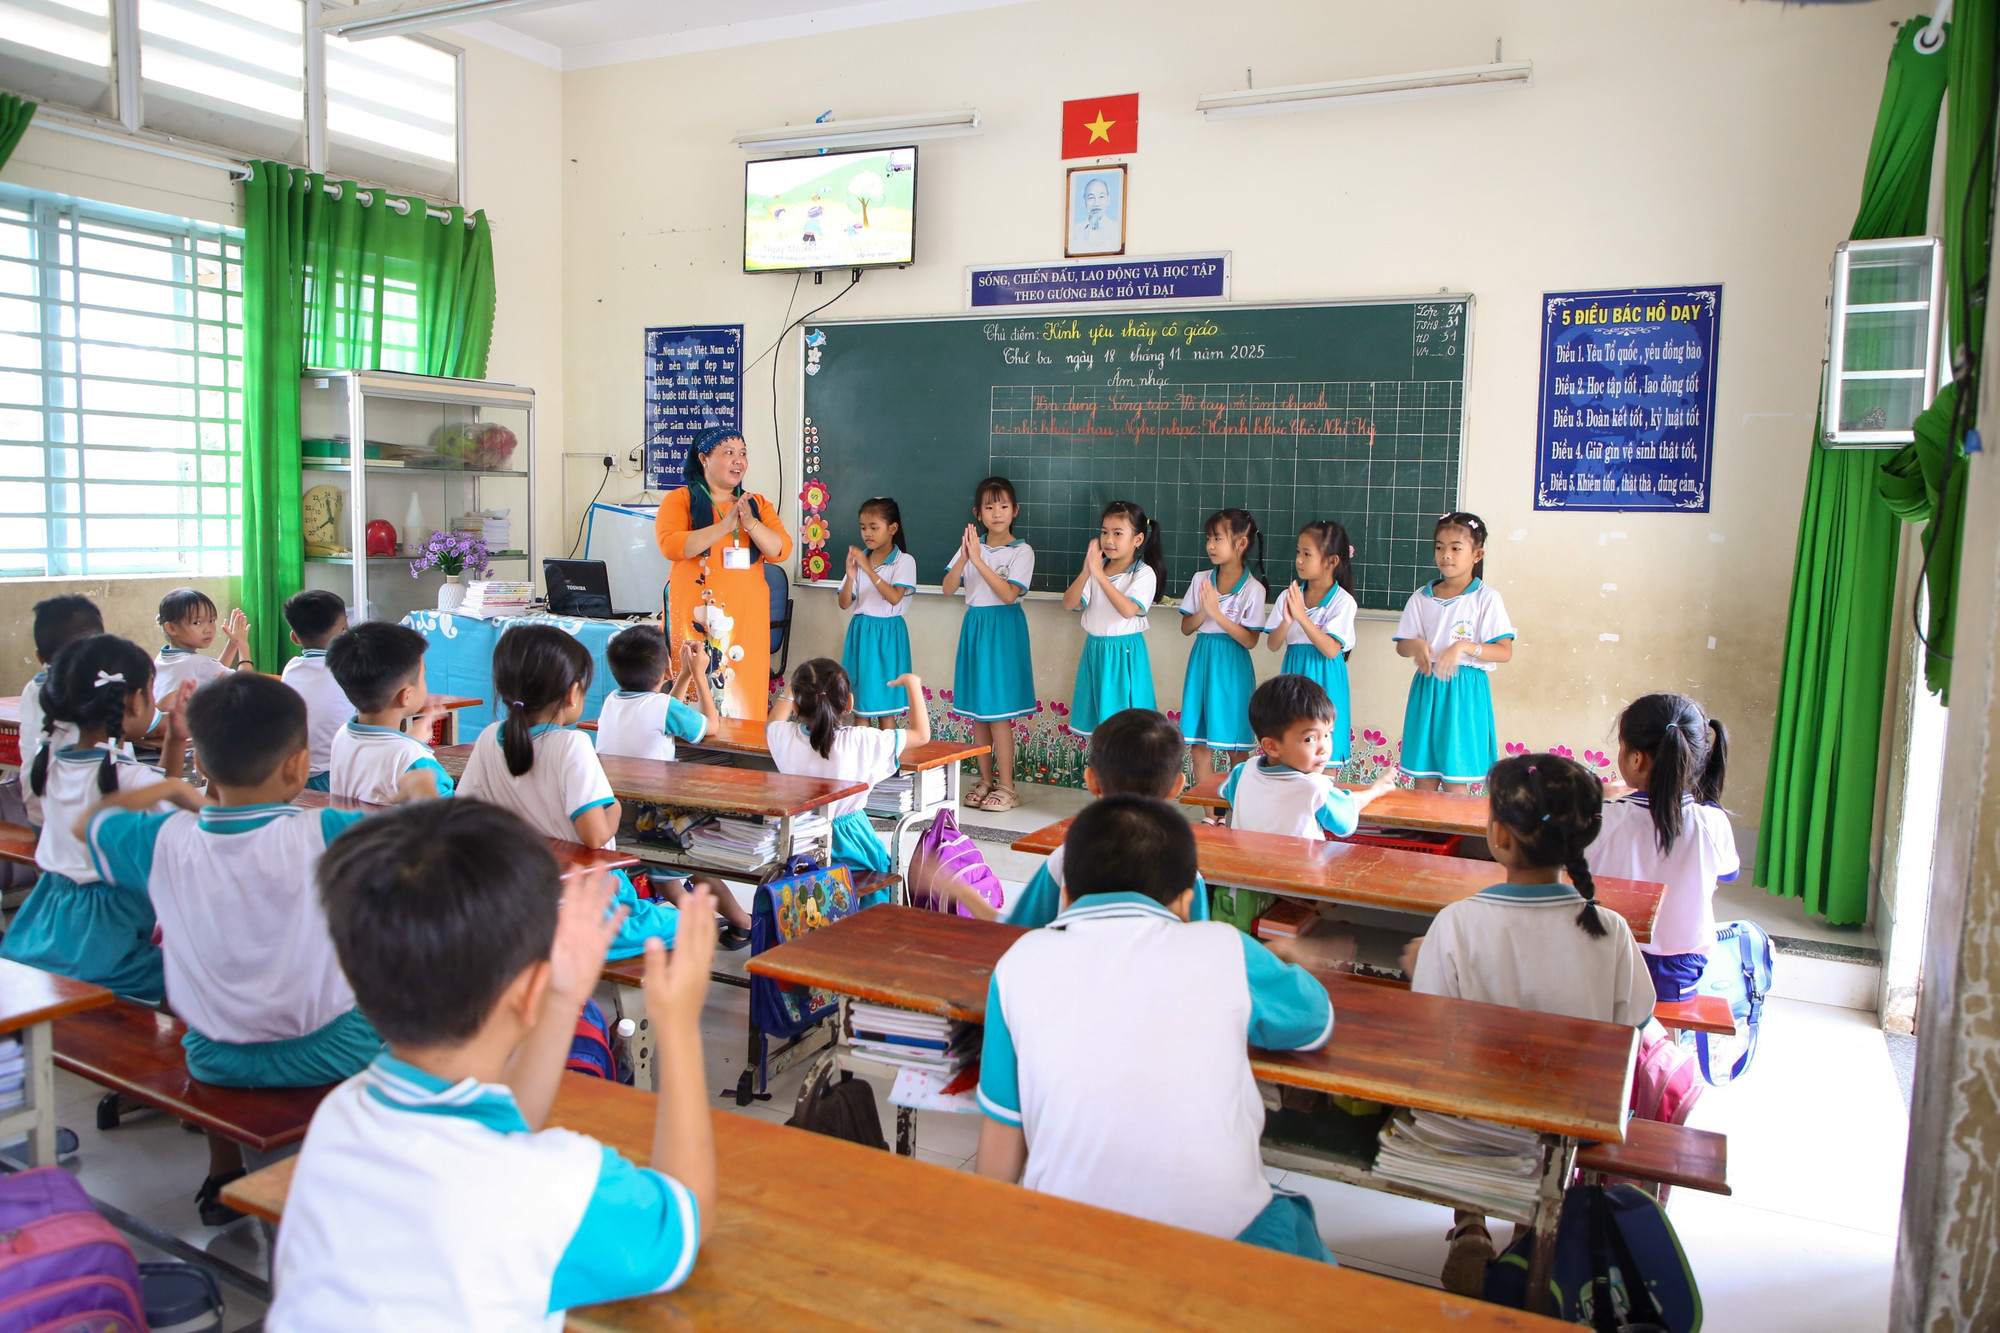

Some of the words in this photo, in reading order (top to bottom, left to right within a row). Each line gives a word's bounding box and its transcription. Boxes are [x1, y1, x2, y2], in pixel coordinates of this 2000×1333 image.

[978, 272, 1010, 288] SỐNG,
[1013, 269, 1048, 285] CHIẾN
[1051, 267, 1078, 284] ĐẤU,
[1081, 270, 1104, 281] LAO
[1107, 266, 1140, 282] ĐỘNG
[1144, 264, 1160, 278] VÀ
[1163, 266, 1190, 280] HỌC
[1192, 262, 1217, 278] TẬP
[1014, 290, 1044, 302] THEO
[1048, 287, 1087, 300] GƯƠNG
[1090, 284, 1114, 298] BÁC
[1117, 281, 1134, 297] HỒ
[1138, 283, 1150, 296] VĨ
[1153, 285, 1174, 298] ĐẠI
[1446, 316, 1459, 328] 31
[1448, 304, 1463, 315] 2A
[1562, 310, 1570, 325] 5
[1575, 302, 1608, 324] ĐIỀU
[1613, 303, 1642, 323] BÁC
[1646, 300, 1666, 322] HỒ
[1671, 304, 1702, 324] DẠY
[983, 324, 1006, 340] Chủ
[1042, 320, 1081, 340] Kính
[1088, 324, 1114, 345] yêu
[1122, 320, 1156, 345] thầy
[1162, 323, 1178, 336] cô
[1185, 319, 1218, 344] giáo
[694, 345, 707, 356] Việt
[710, 346, 724, 354] Nam
[726, 344, 734, 354] có
[1003, 347, 1030, 364] Thứ
[1036, 348, 1052, 364] ba
[1066, 350, 1094, 372] ngày
[1104, 350, 1116, 362] 18
[1130, 344, 1165, 370] tháng
[1170, 347, 1181, 360] 11
[1193, 346, 1225, 360] năm
[1230, 344, 1266, 360] 2025
[1556, 342, 1575, 363] Điều
[1578, 346, 1584, 362] 1.
[1586, 344, 1602, 362] Yêu
[1605, 340, 1616, 361] Tổ
[1644, 346, 1660, 364] yêu
[1662, 338, 1683, 364] đồng
[1686, 340, 1702, 359] bào
[704, 360, 717, 372] đẹp
[723, 360, 734, 371] hay
[1107, 368, 1134, 386] Âm
[1139, 369, 1170, 389] nhạc
[691, 376, 702, 386] tộc
[704, 375, 718, 386] Việt
[720, 375, 734, 384] Nam
[1554, 374, 1575, 395] Điều
[1577, 378, 1584, 394] 2.
[1586, 376, 1604, 398] Học
[1606, 374, 1622, 398] tập
[1644, 376, 1658, 393] lao
[1660, 374, 1683, 397] động
[1686, 370, 1700, 392] tốt
[679, 405, 688, 414] vai
[715, 392, 734, 402] quang
[1200, 398, 1226, 419] tay
[1252, 398, 1276, 409] âm
[1281, 391, 1328, 409] thanh
[1553, 406, 1574, 428] Điều
[1576, 411, 1584, 428] 3.
[1586, 408, 1610, 426] Đoàn
[1612, 404, 1628, 426] kết
[1650, 406, 1662, 430] kỷ
[1664, 408, 1683, 430] luật
[1686, 404, 1700, 426] tốt
[1041, 418, 1072, 434] khác
[1122, 418, 1156, 444] Nghe
[1202, 417, 1248, 434] Hành
[1254, 416, 1288, 434] khúc
[1552, 438, 1574, 460] Điều
[1575, 444, 1583, 460] 4.
[1585, 440, 1604, 460] Giữ
[1604, 444, 1620, 464] gìn
[1622, 444, 1633, 463] vệ
[1636, 440, 1656, 460] sinh
[1658, 440, 1679, 463] thật
[1682, 438, 1698, 462] tốt,
[1550, 470, 1568, 491] Điều
[1569, 474, 1575, 491] 5.
[1577, 473, 1600, 492] Khiêm
[1622, 474, 1638, 495] thật
[1658, 474, 1678, 496] dũng
[566, 584, 586, 592] TOSHIBA
